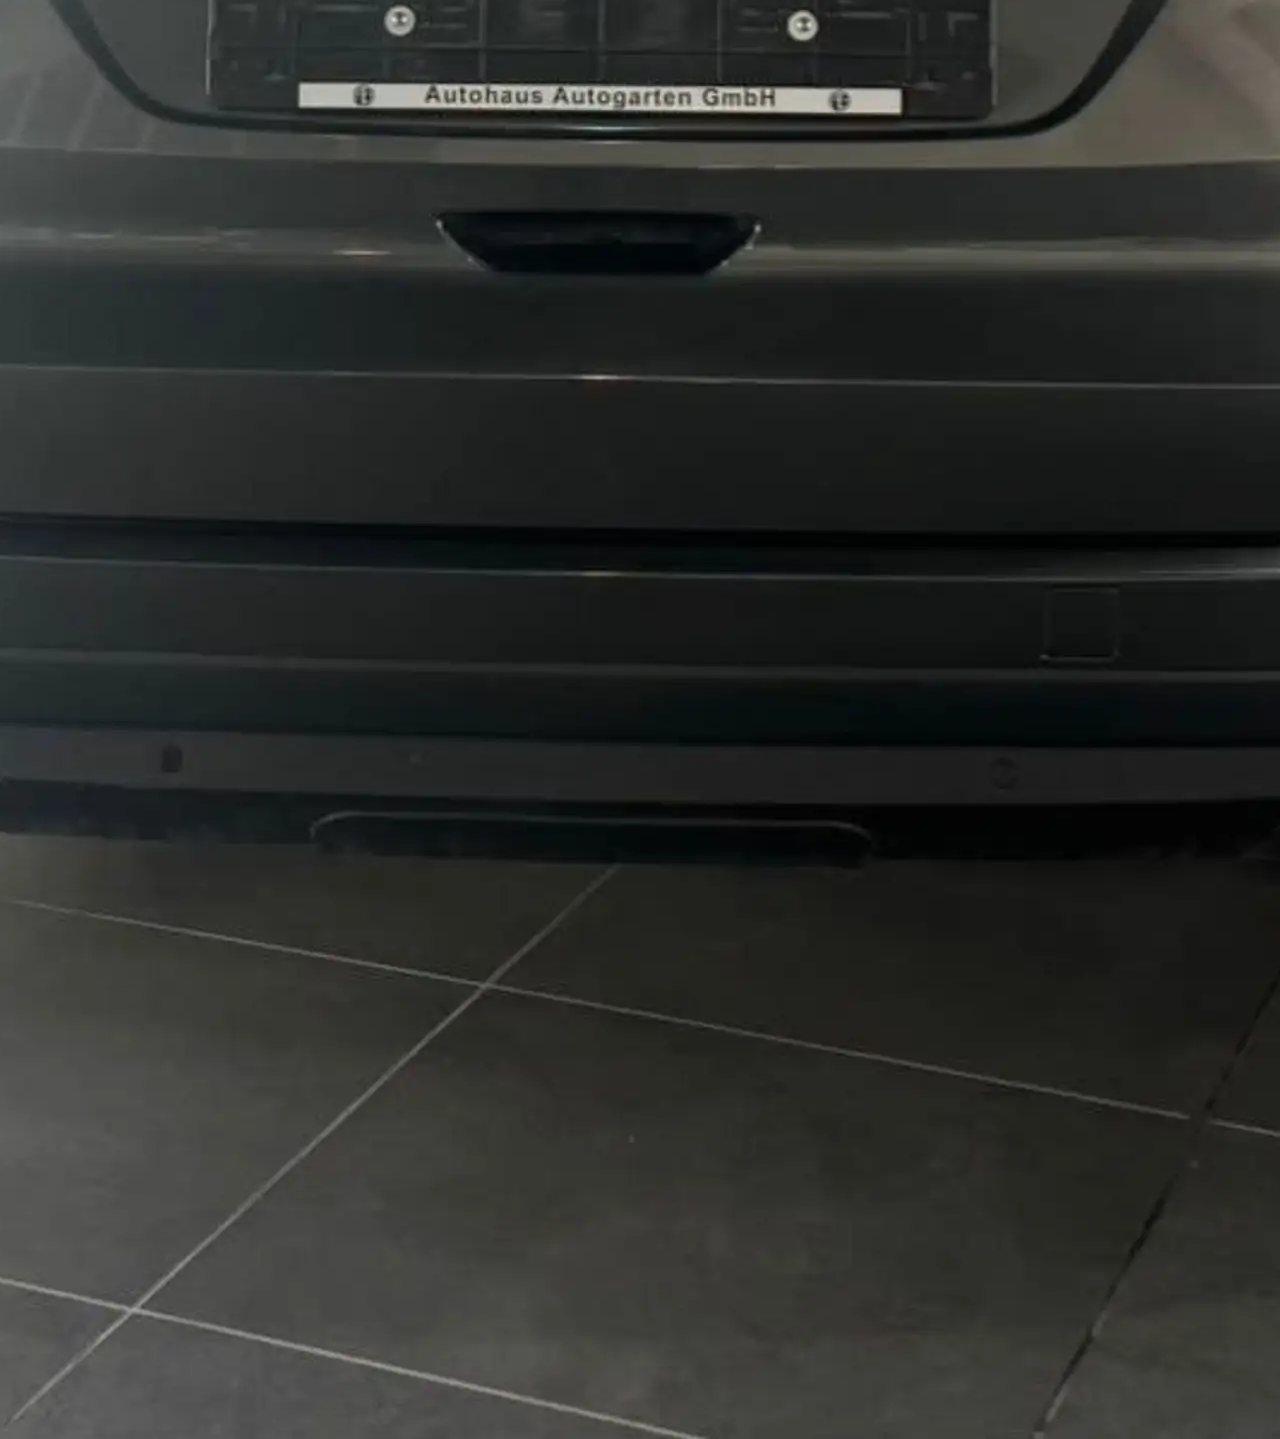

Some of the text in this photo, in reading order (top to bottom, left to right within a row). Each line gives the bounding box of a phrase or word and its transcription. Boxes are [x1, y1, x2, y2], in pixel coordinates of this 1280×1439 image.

[423, 85, 777, 109] Autohaus Autogarten GmbH
